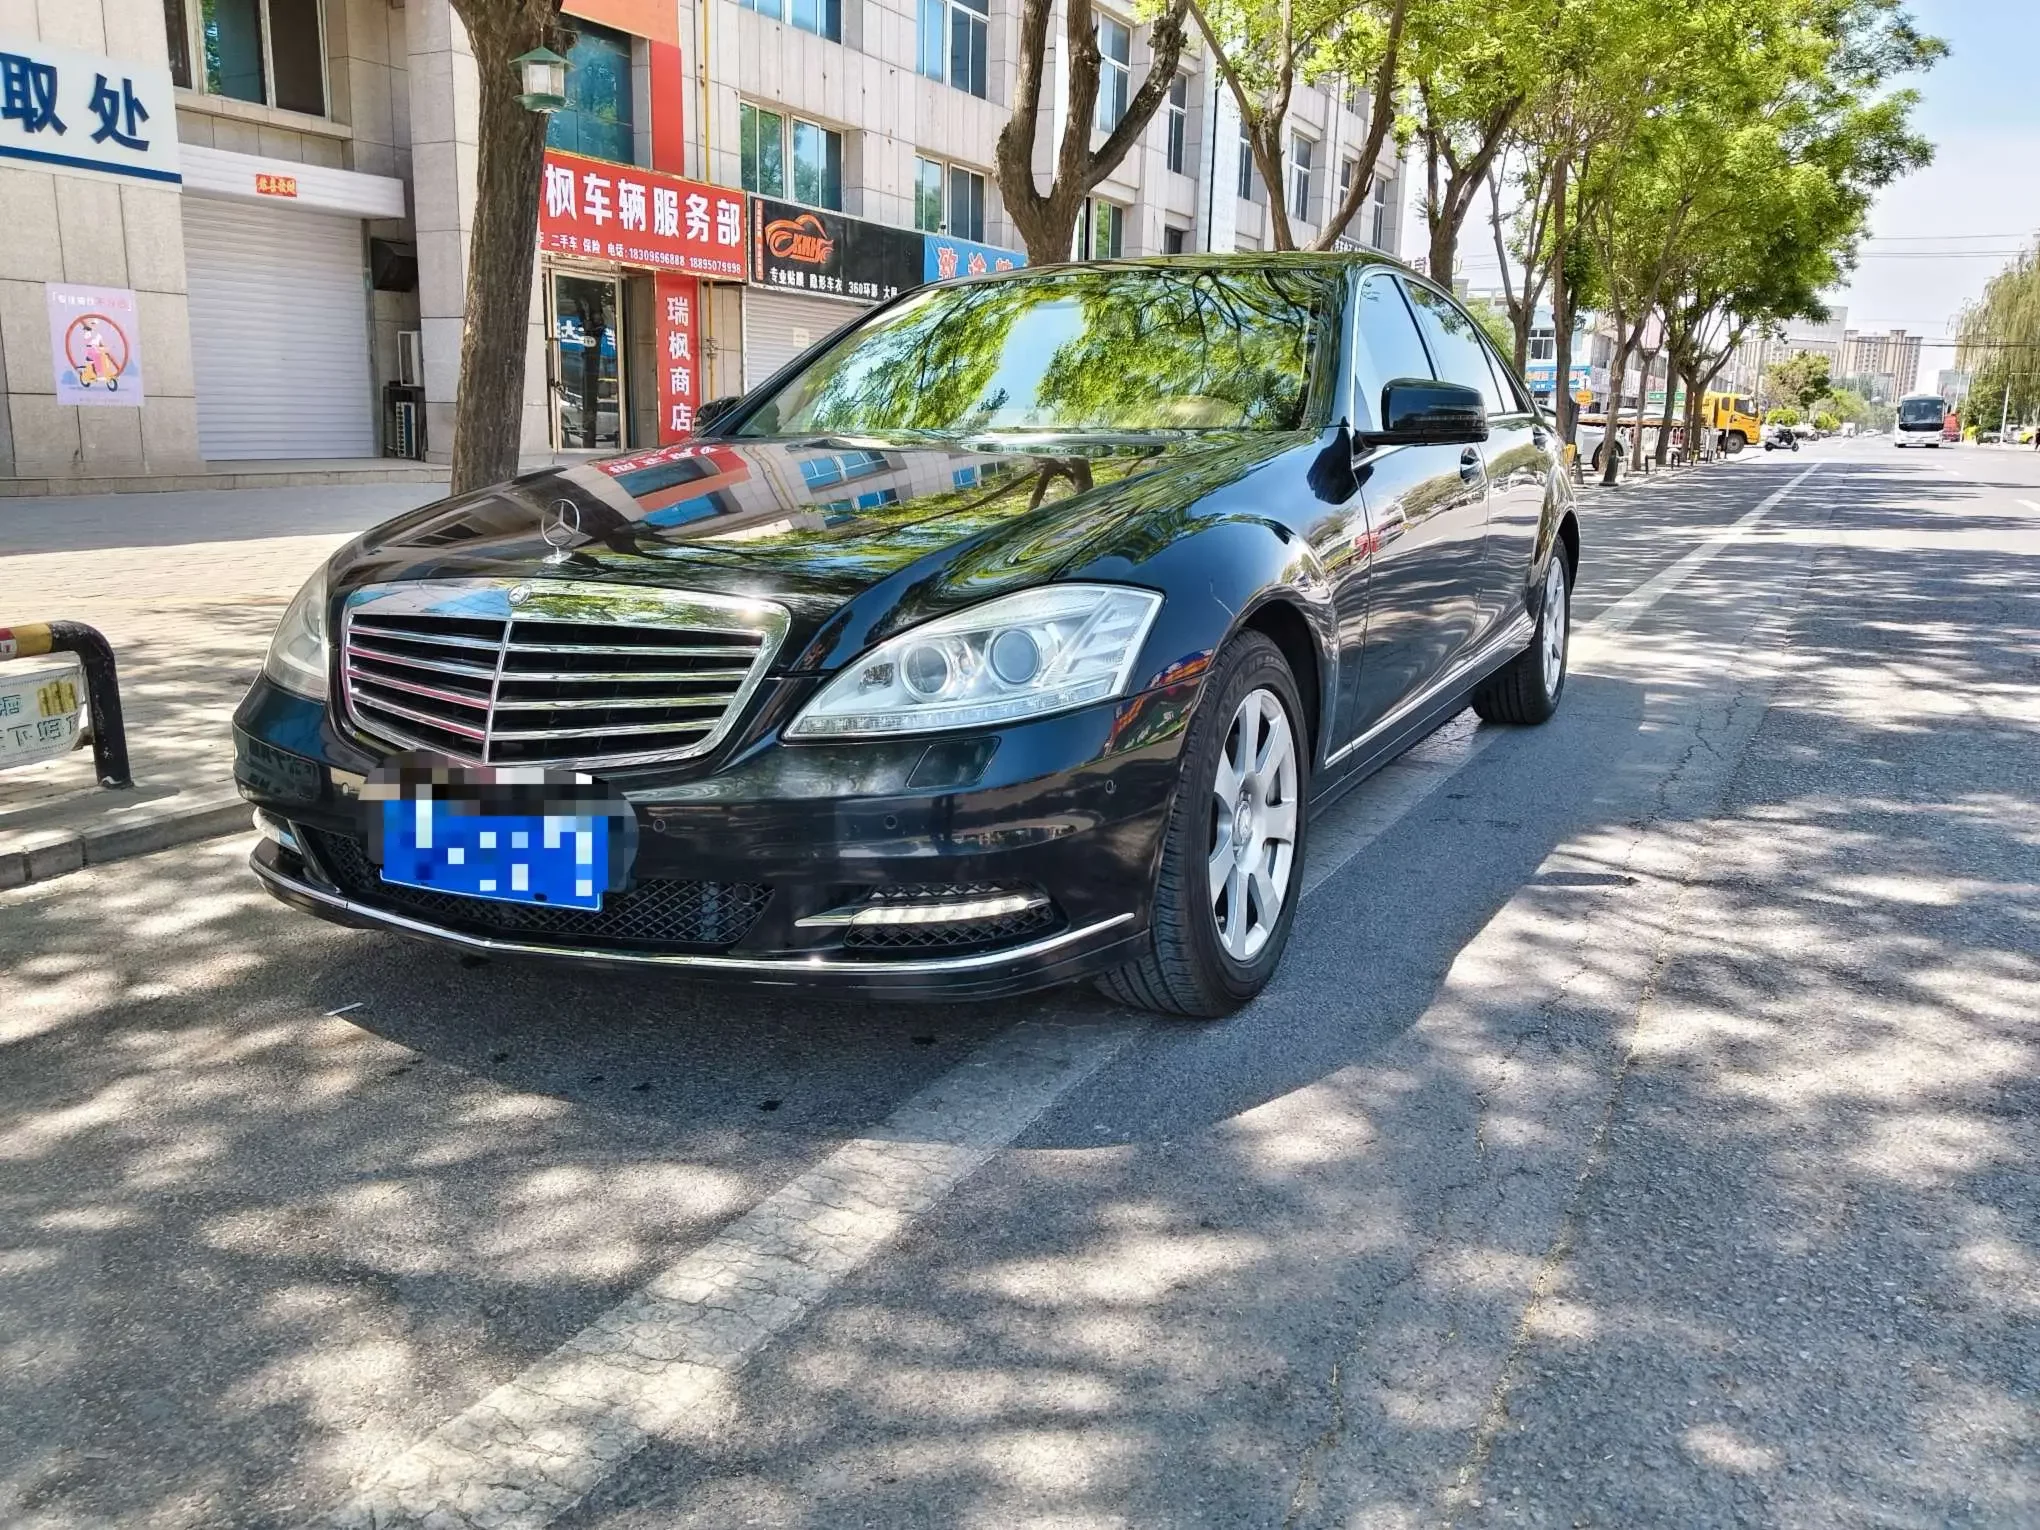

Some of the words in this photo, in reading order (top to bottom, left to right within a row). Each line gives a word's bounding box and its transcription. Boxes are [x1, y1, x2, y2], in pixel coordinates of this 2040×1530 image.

[0, 53, 150, 151] 取处
[545, 163, 741, 248] 枫车辆服务部
[551, 234, 578, 250] 二手车
[583, 238, 600, 253] 保险
[667, 296, 692, 432] 瑞枫商店
